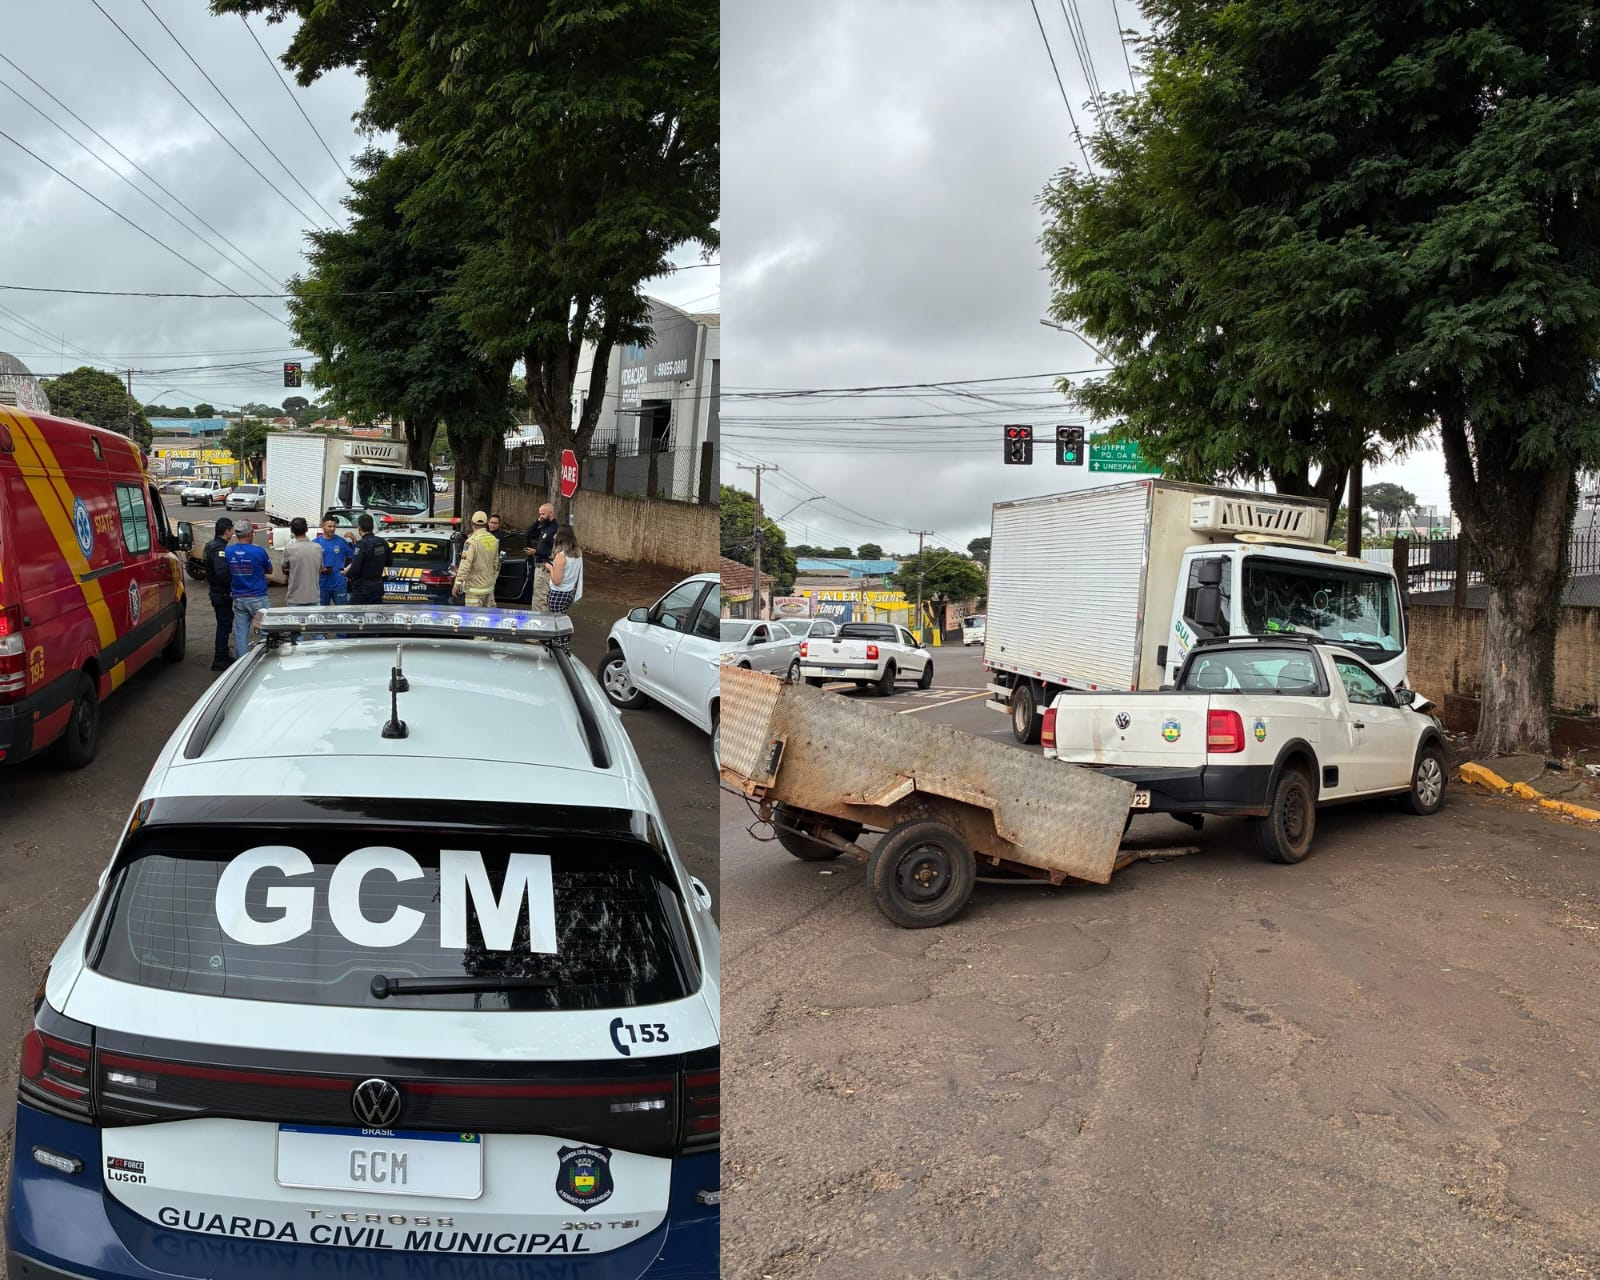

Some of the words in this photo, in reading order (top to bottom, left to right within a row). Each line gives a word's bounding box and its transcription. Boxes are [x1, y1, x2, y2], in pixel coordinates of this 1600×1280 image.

[1103, 463, 1137, 471] UNESPAR
[819, 603, 846, 617] Energy
[1175, 620, 1190, 648] SUL
[30, 662, 45, 685] 193
[215, 845, 558, 954] GCM
[625, 1023, 670, 1043] 153
[361, 1128, 396, 1137] BRASIL
[124, 1160, 144, 1170] FORCE
[350, 1149, 408, 1185] GCM
[107, 1168, 147, 1184] Luson
[304, 1208, 455, 1228] T-CROSS
[560, 1221, 602, 1231] 200
[607, 1219, 640, 1230] TSI
[158, 1206, 298, 1242] GUARDA
[309, 1224, 393, 1249] CIVIL
[404, 1230, 590, 1254] MUNICIPAL
